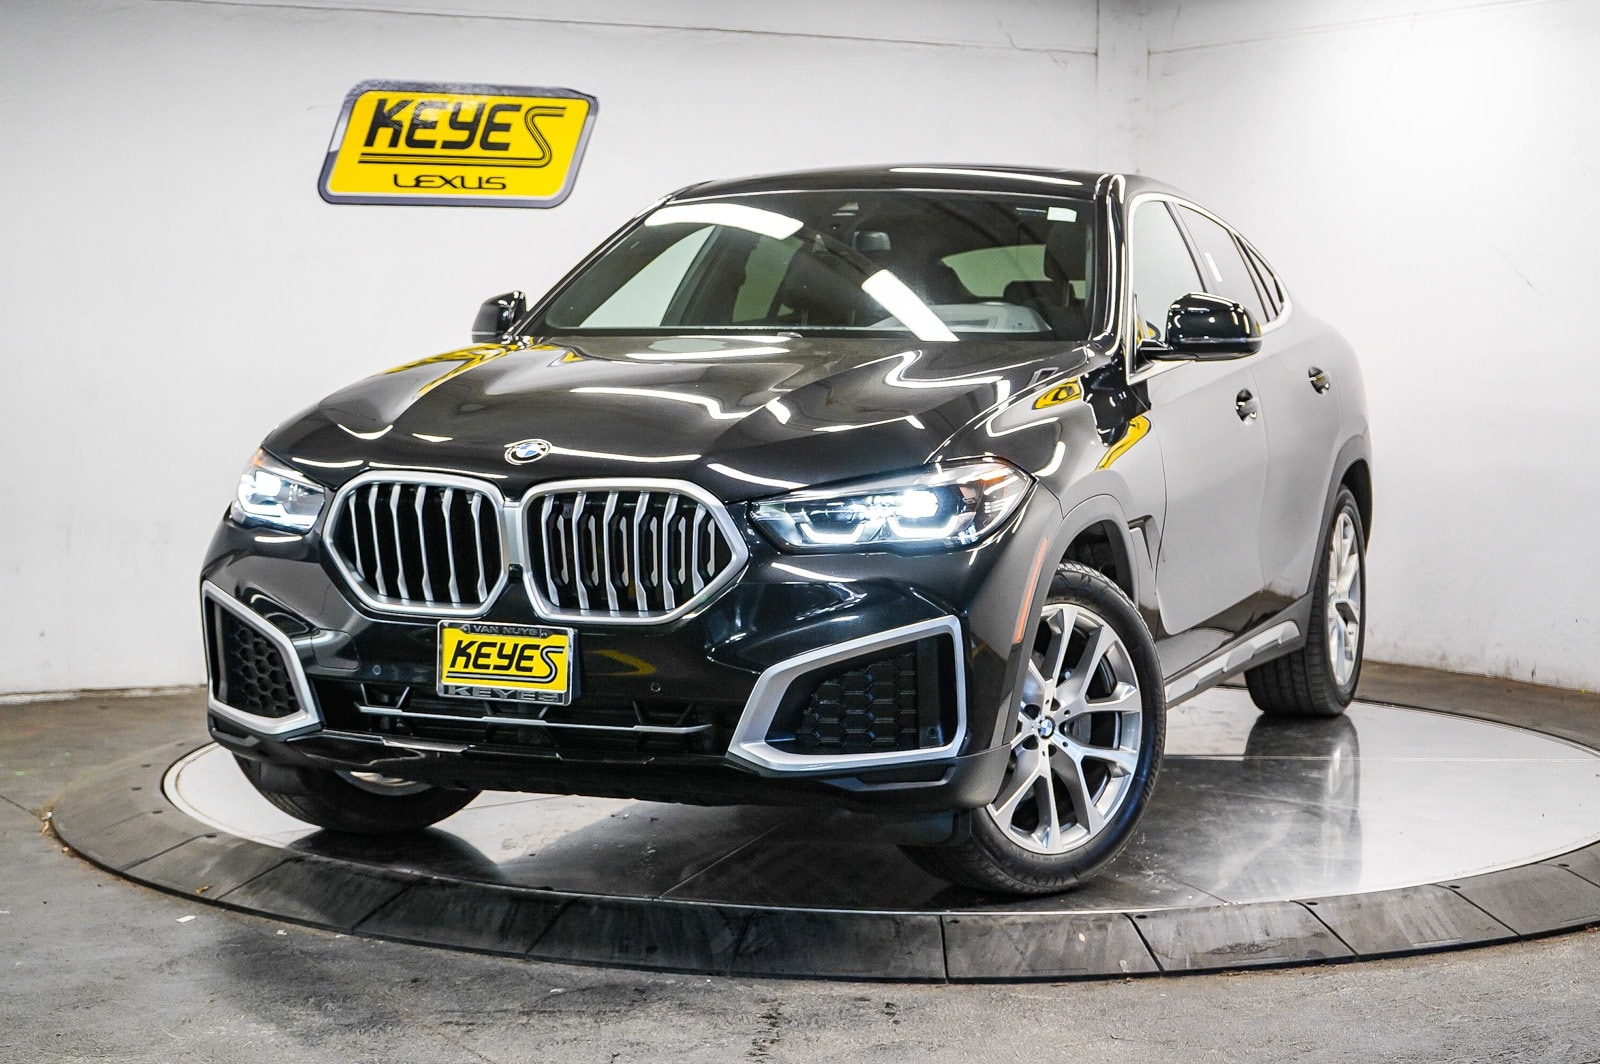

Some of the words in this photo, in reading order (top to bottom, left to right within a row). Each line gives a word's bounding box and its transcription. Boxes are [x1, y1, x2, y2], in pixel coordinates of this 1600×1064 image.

[360, 98, 568, 168] KEYES
[393, 173, 507, 190] LEXUS
[473, 624, 499, 634] VAN
[447, 639, 566, 684] KEYES
[448, 686, 559, 702] KEYES
